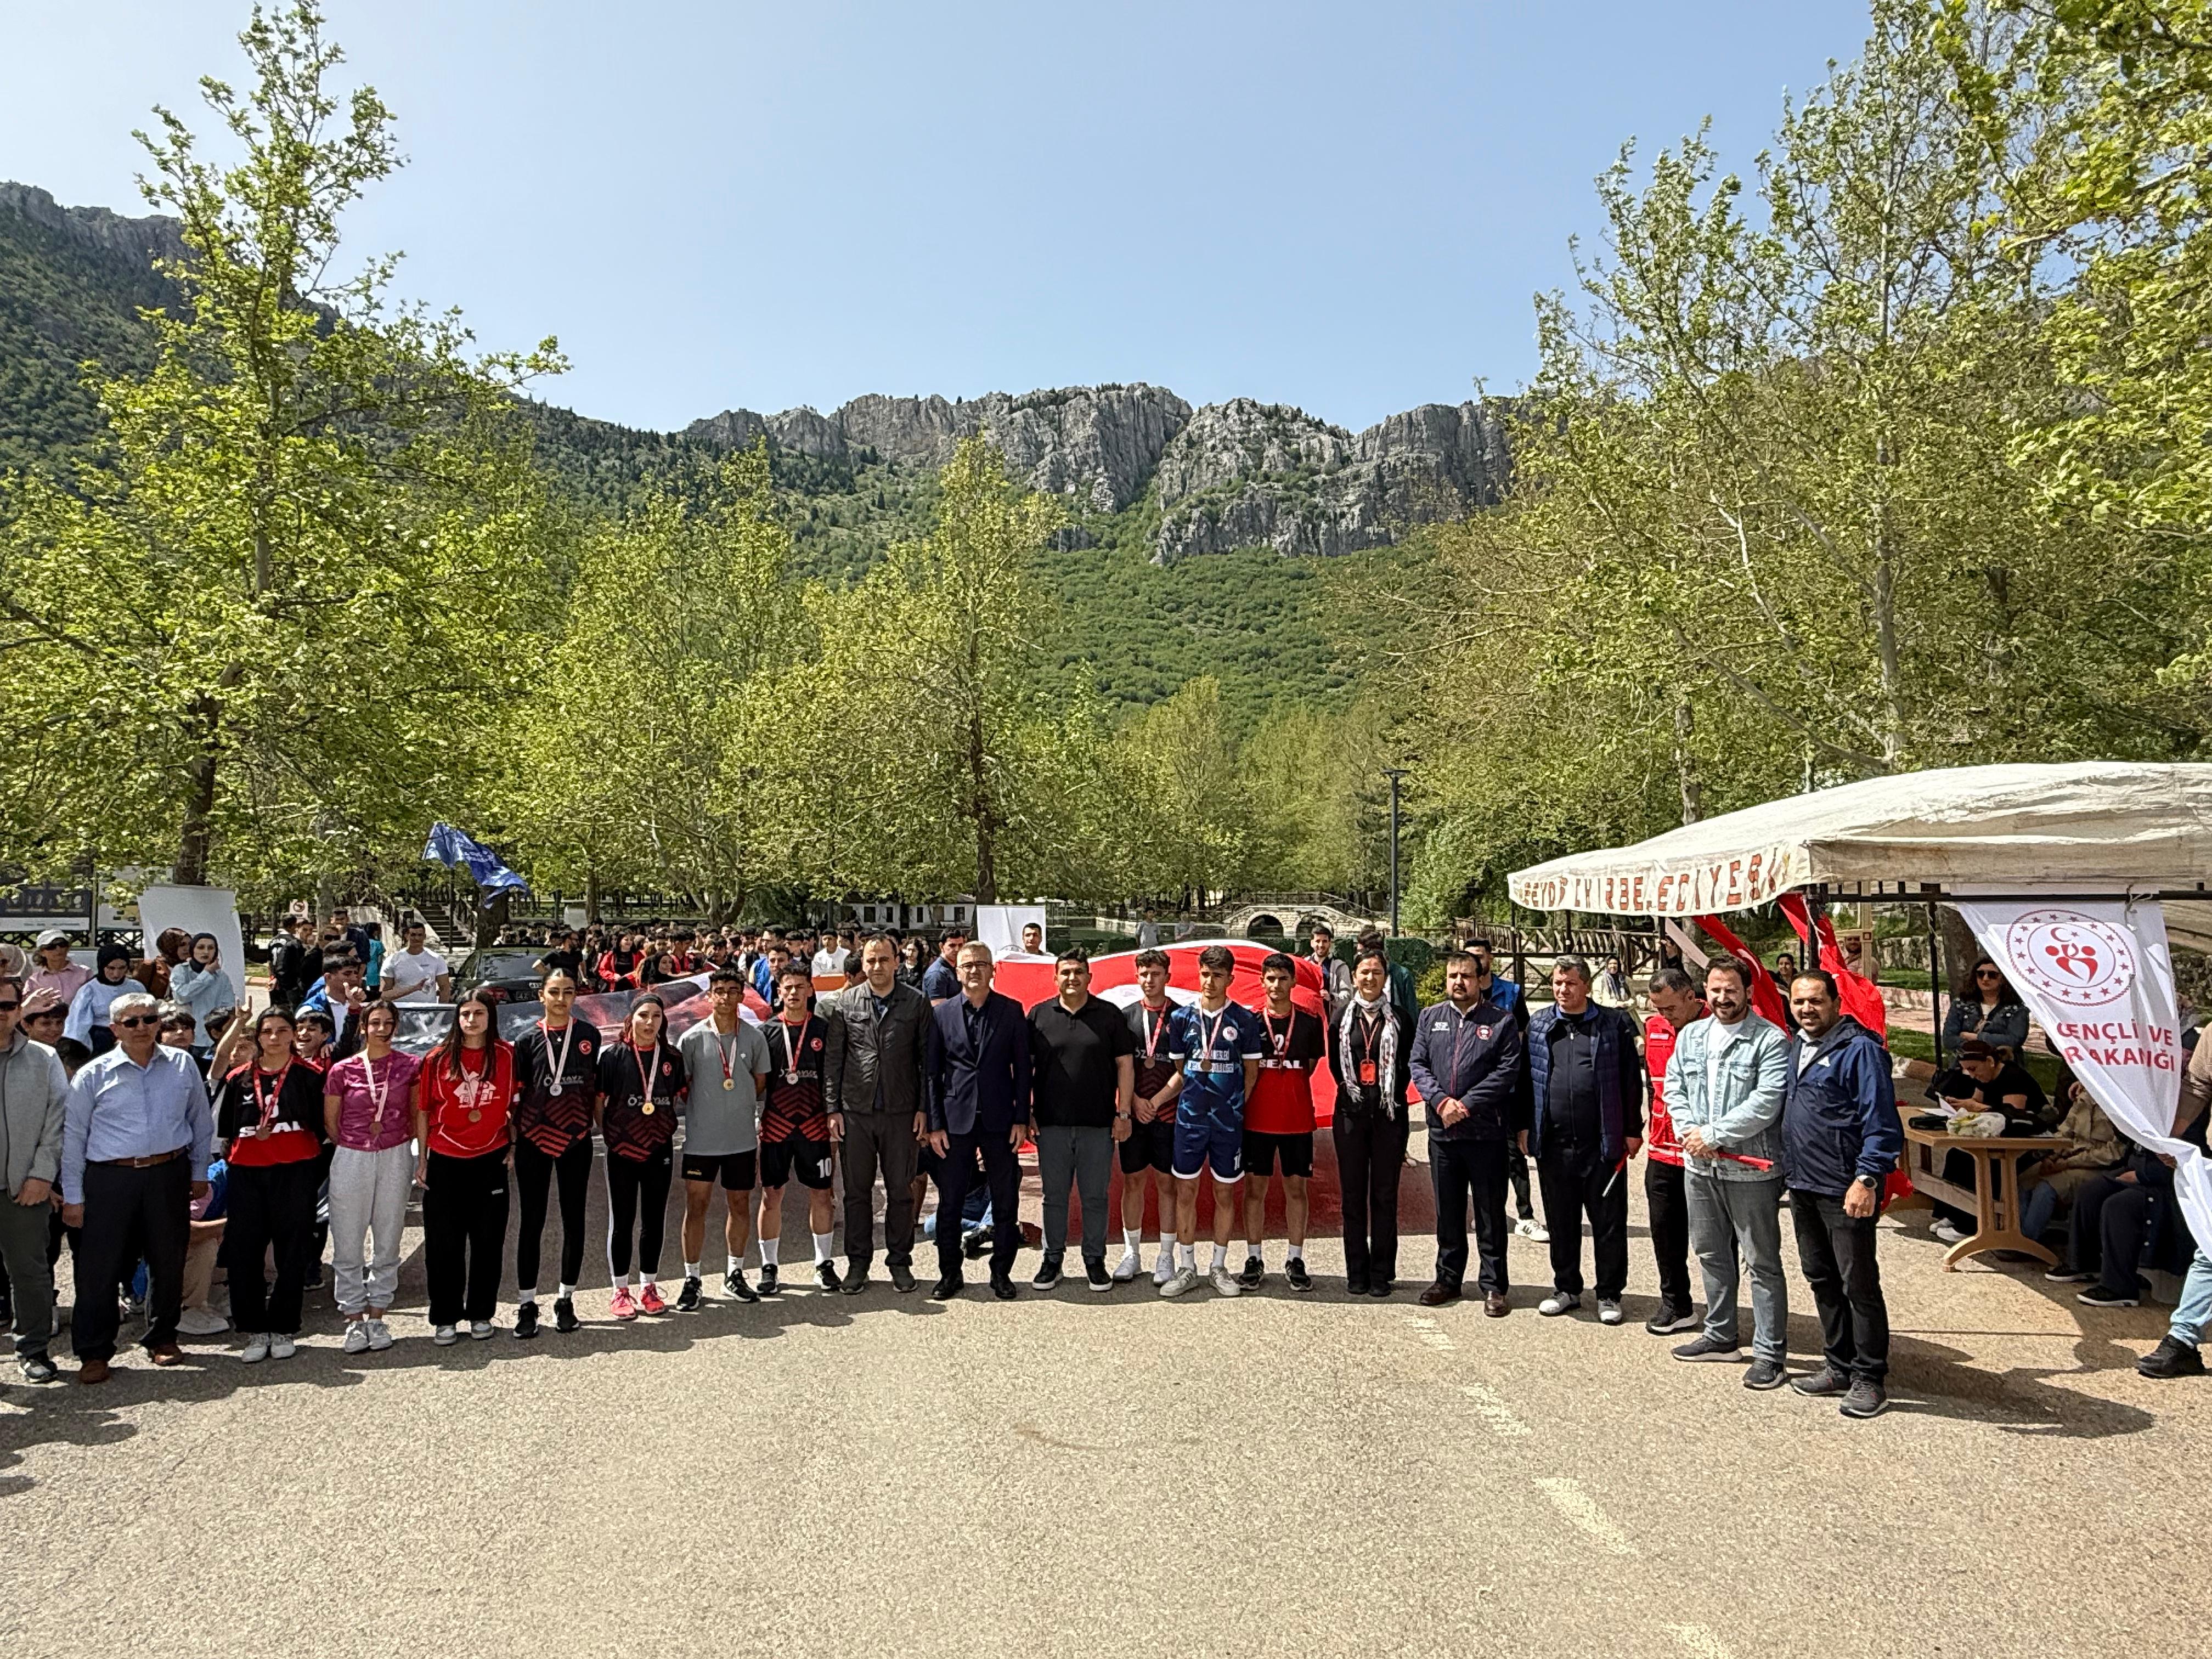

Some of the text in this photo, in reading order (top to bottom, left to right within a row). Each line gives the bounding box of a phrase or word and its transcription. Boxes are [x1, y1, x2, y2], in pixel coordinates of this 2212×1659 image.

[1273, 1034, 1285, 1056] 2
[2148, 1025, 2174, 1046] VE
[1259, 1059, 1304, 1069] SEAL
[816, 1158, 832, 1178] 10
